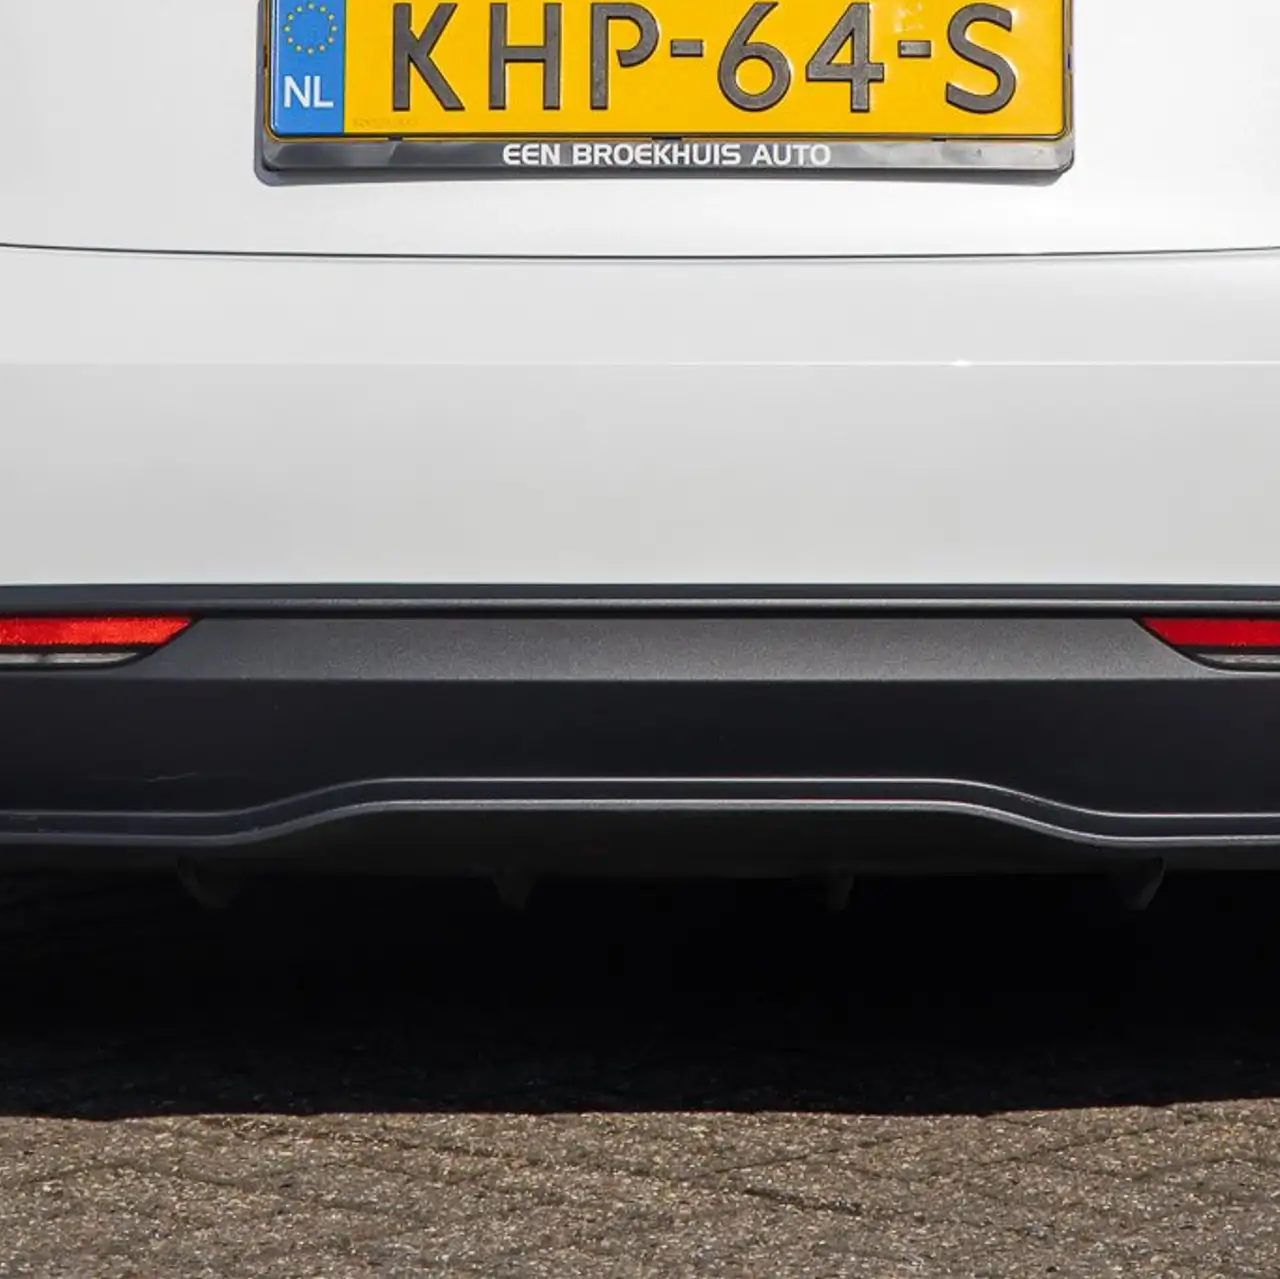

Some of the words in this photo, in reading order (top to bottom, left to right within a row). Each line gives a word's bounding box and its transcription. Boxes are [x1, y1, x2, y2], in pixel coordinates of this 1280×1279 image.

[392, 2, 1017, 114] KHP-64-S
[283, 75, 334, 108] NL
[503, 143, 560, 165] EEN
[572, 143, 741, 165] BROEKHUIS
[751, 143, 832, 166] AUTO
